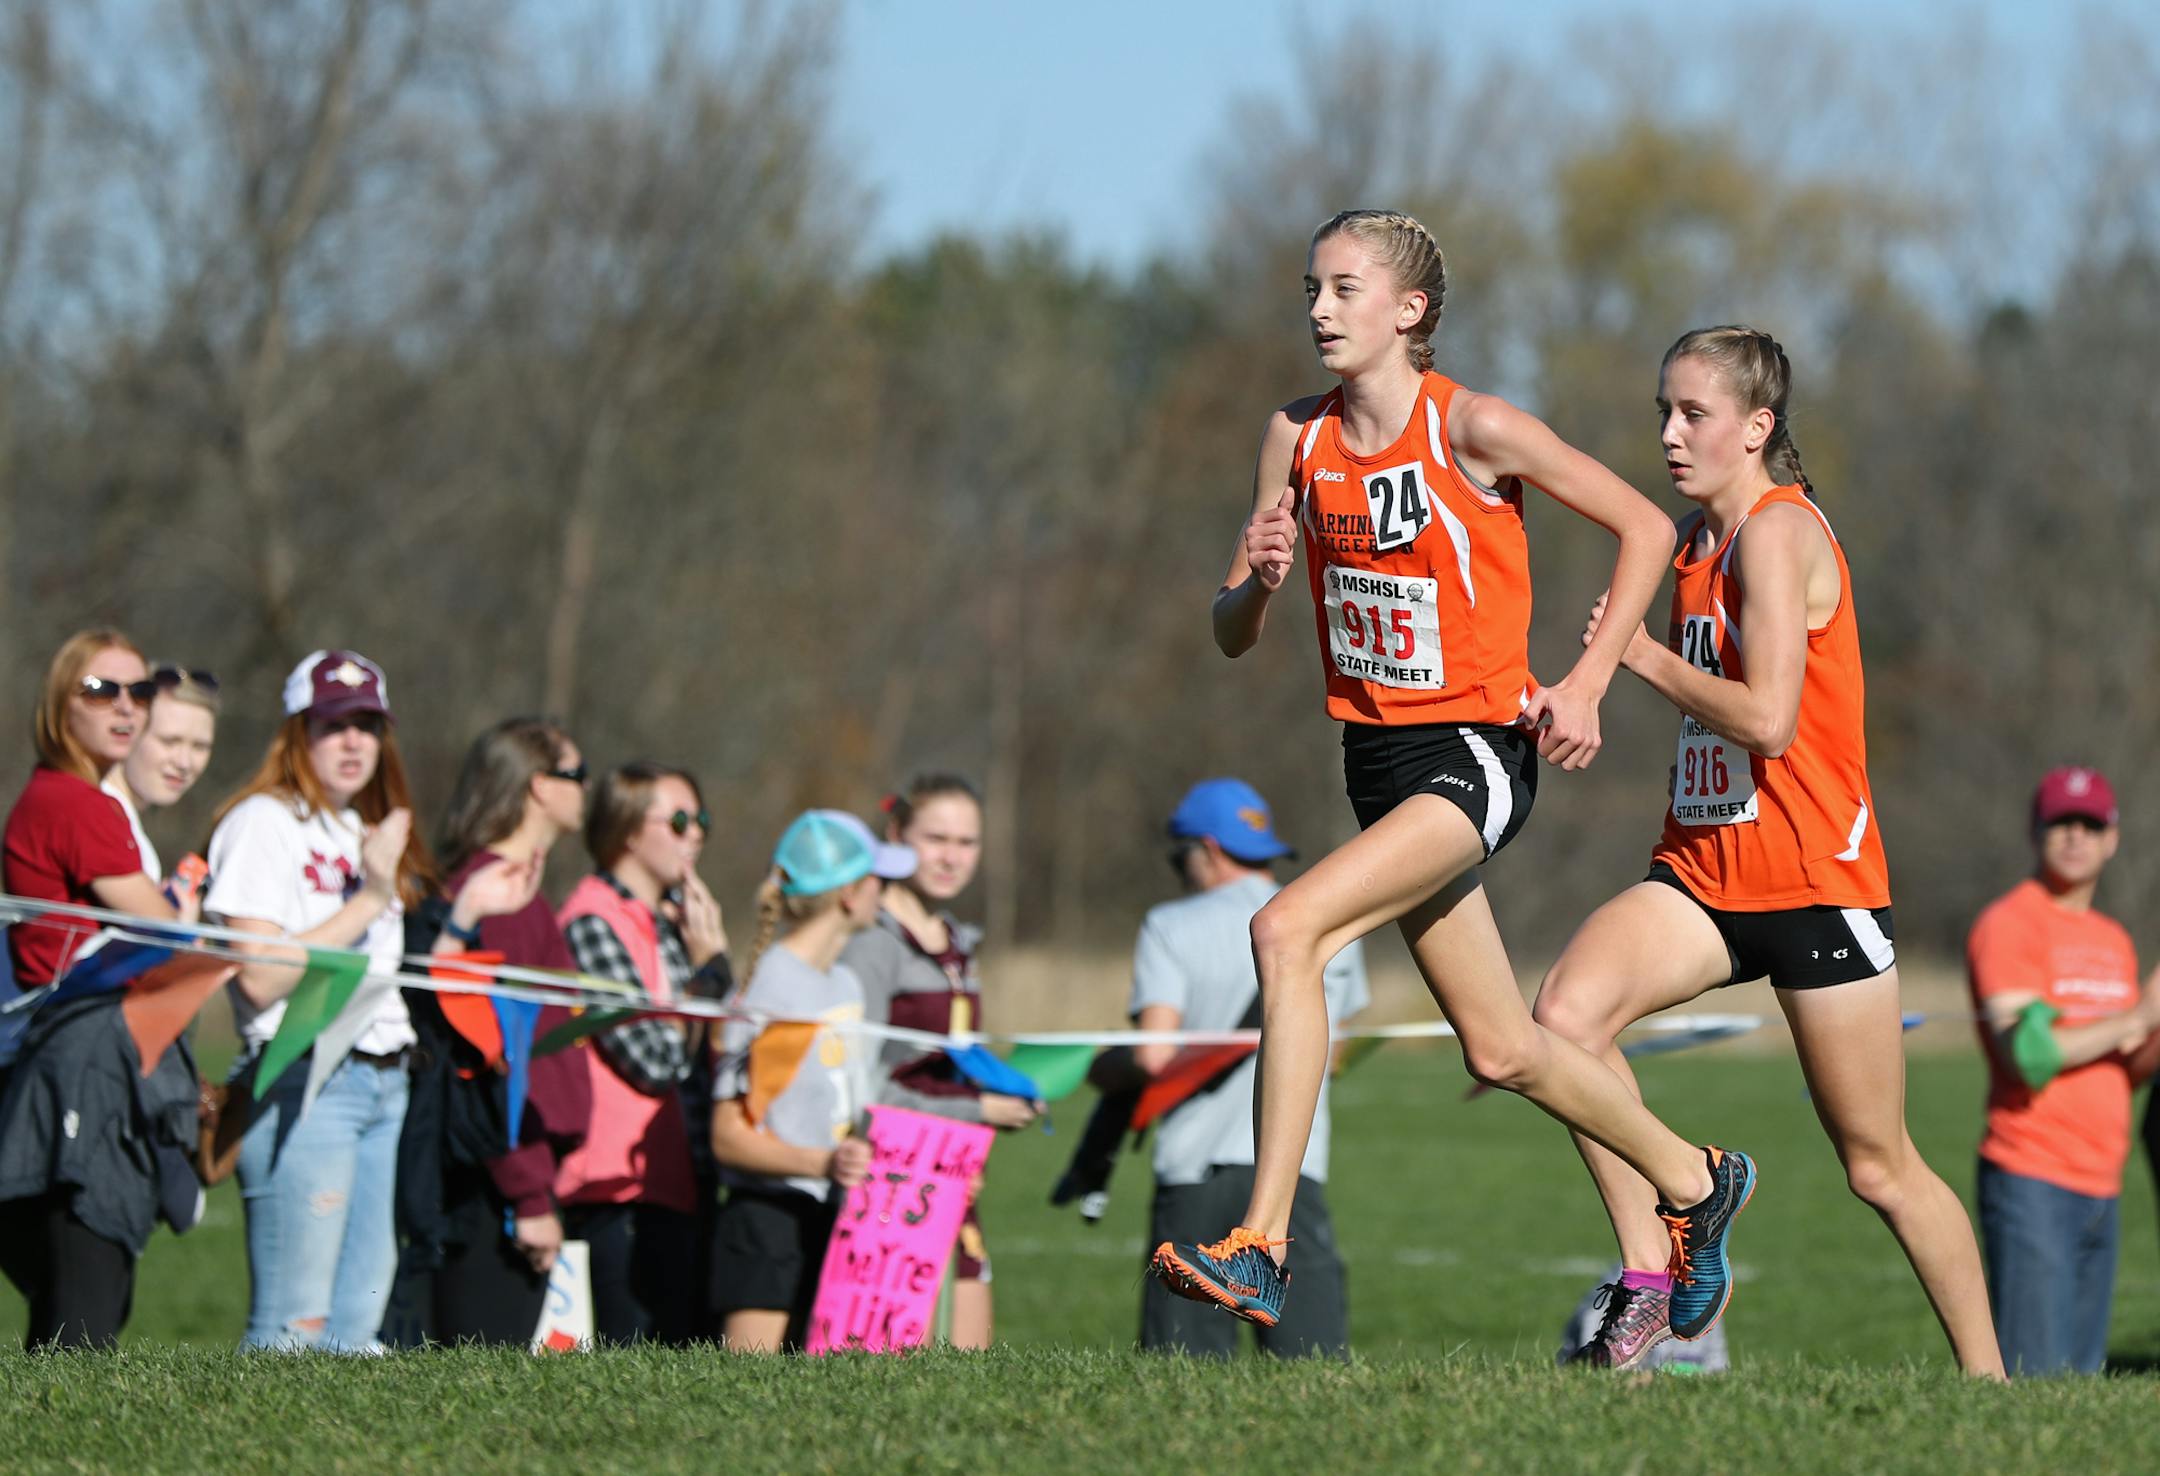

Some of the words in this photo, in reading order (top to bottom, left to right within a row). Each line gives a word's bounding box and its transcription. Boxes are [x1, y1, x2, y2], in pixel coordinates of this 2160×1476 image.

[1369, 469, 1428, 545] 24
[1342, 573, 1405, 600] MSHSL
[1342, 600, 1416, 661] 915
[1685, 619, 1721, 678] 24
[1337, 653, 1381, 676] STATE
[1384, 666, 1432, 683] MEET
[1684, 745, 1730, 797] 916
[1676, 804, 1705, 819] STATE
[1707, 800, 1748, 817] MEET
